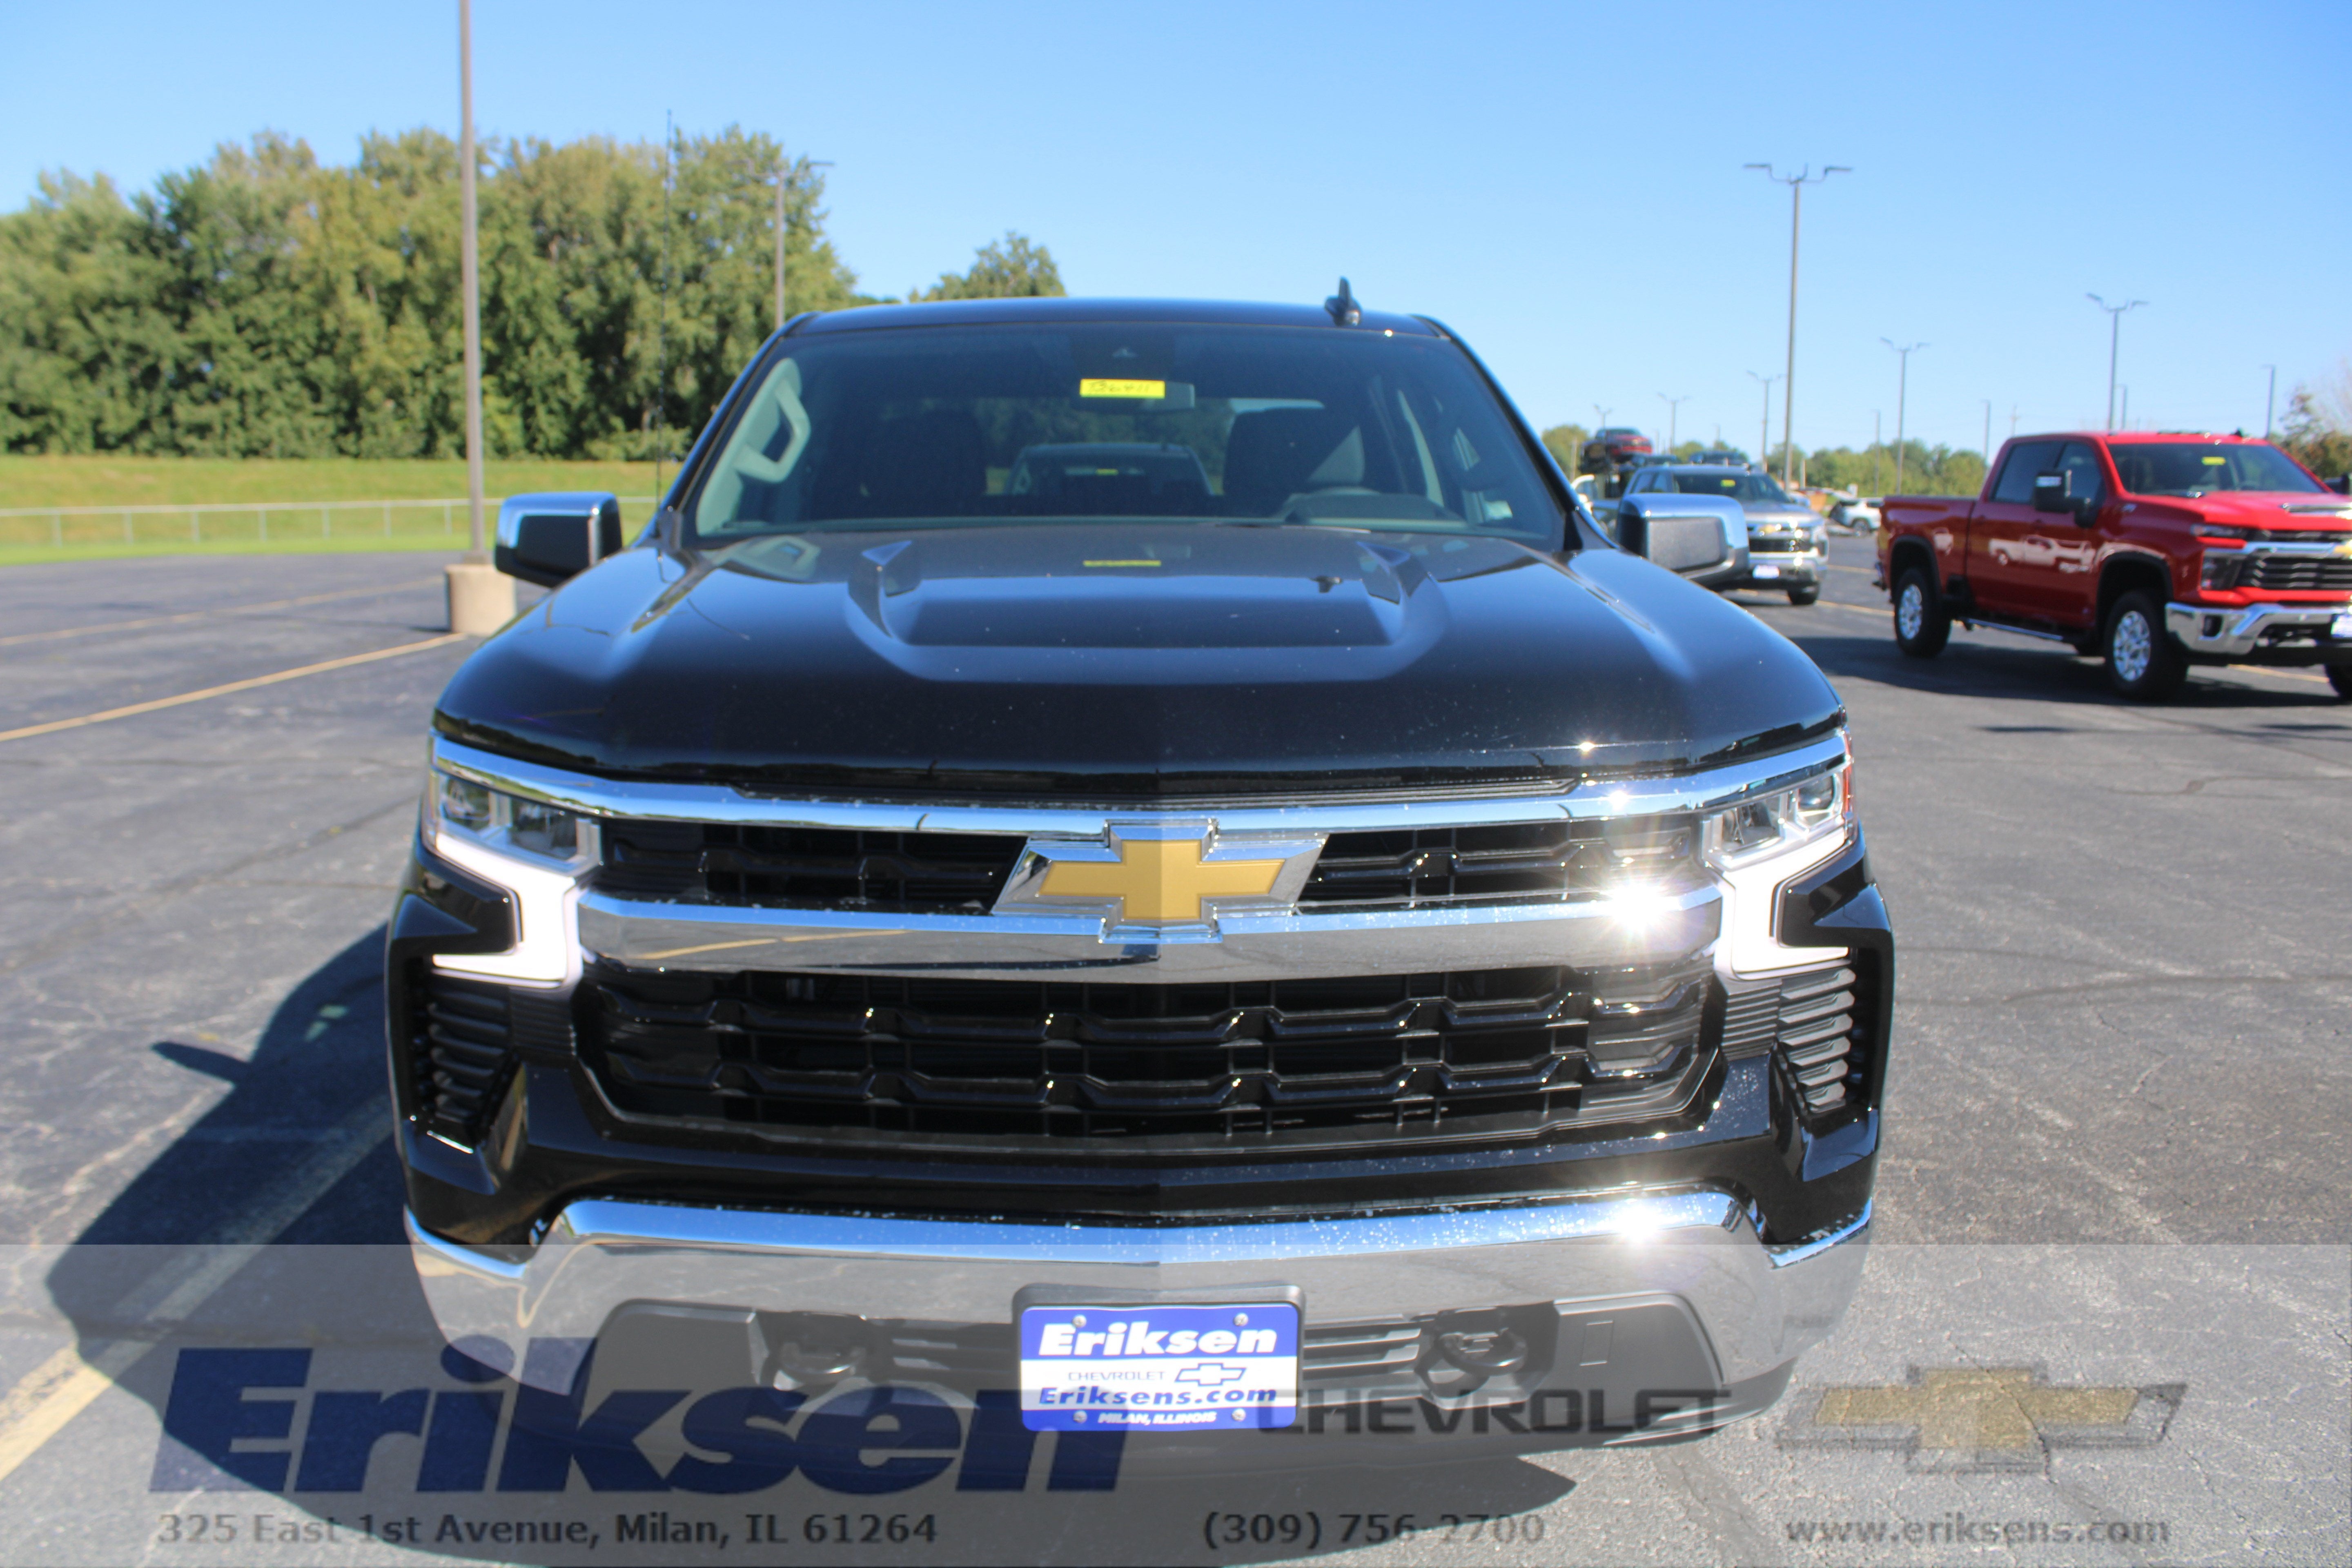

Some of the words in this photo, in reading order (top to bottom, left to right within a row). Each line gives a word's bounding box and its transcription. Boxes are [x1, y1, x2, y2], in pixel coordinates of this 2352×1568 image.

[1039, 1321, 1277, 1356] Eriksen
[1068, 1371, 1165, 1381] CHEVROLET
[1039, 1385, 1276, 1405] Eriksens.com
[1098, 1412, 1151, 1426] MILAN,
[1153, 1412, 1217, 1425] ILLINOIS
